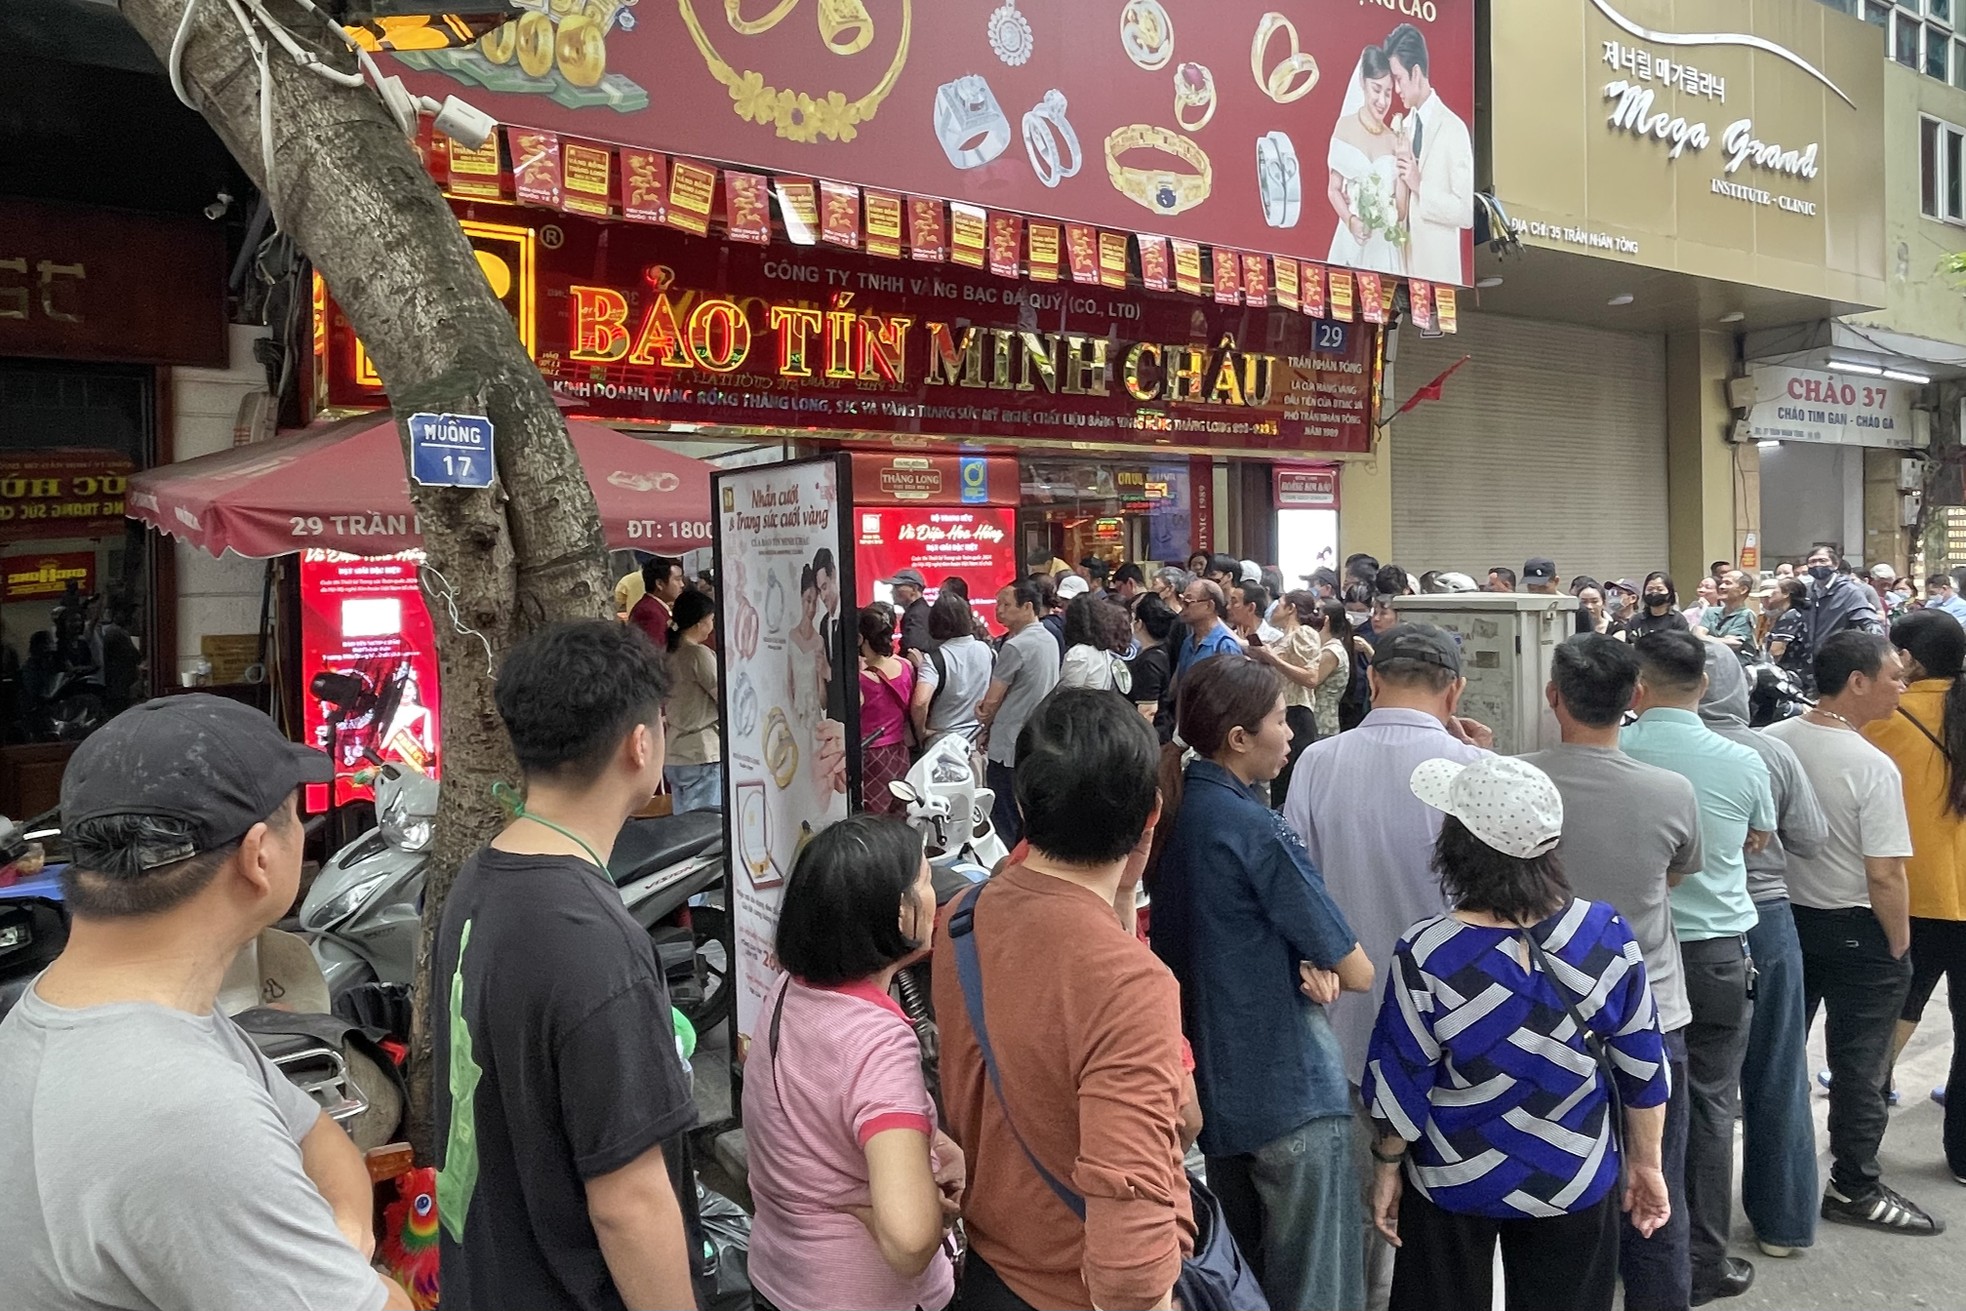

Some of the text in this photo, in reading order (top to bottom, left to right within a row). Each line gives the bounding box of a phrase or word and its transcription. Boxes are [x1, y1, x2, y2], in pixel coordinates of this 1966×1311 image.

[1399, 0, 1436, 22] CAO
[1604, 80, 1818, 178] Mega Grand
[1711, 179, 1771, 205] INSTITUTE
[1778, 195, 1816, 216] CLINIC
[1511, 218, 1527, 235] ĐỊA
[1550, 225, 1561, 239] 35
[1590, 232, 1613, 249] NHÂN
[764, 260, 818, 283] CÔNG
[826, 268, 850, 285] TY
[858, 273, 904, 292] TNHH
[911, 276, 957, 299] VÀNG
[963, 285, 997, 307] BẠC
[1030, 292, 1062, 312] QUÝ
[1109, 301, 1140, 321] LTD)
[569, 265, 1276, 407] BẢO TÍN MINH CHÂU
[1320, 325, 1343, 347] 29
[554, 381, 591, 397] KINH
[594, 383, 650, 401] DOANH
[653, 385, 693, 403] VÀNG
[743, 391, 789, 410] THĂNG
[881, 400, 915, 417] VÀNG
[918, 404, 956, 419] TRANG
[1862, 386, 1887, 410] 37
[1808, 410, 1825, 424] TIM
[1828, 411, 1847, 425] GAN
[424, 419, 481, 443] MUỒNG
[443, 455, 472, 476] 17
[882, 473, 939, 485] THĂNG LONG
[752, 483, 799, 508] Nhẫn cưới
[289, 509, 406, 535] 29 TRẦN
[627, 520, 662, 538] ĐT:
[737, 511, 761, 534] Trang
[763, 509, 778, 529] sức
[780, 505, 800, 527] cưới
[803, 504, 829, 529] vàng
[946, 524, 972, 541] Hoa
[973, 523, 1004, 544] Hồng
[644, 864, 694, 890] VISION
